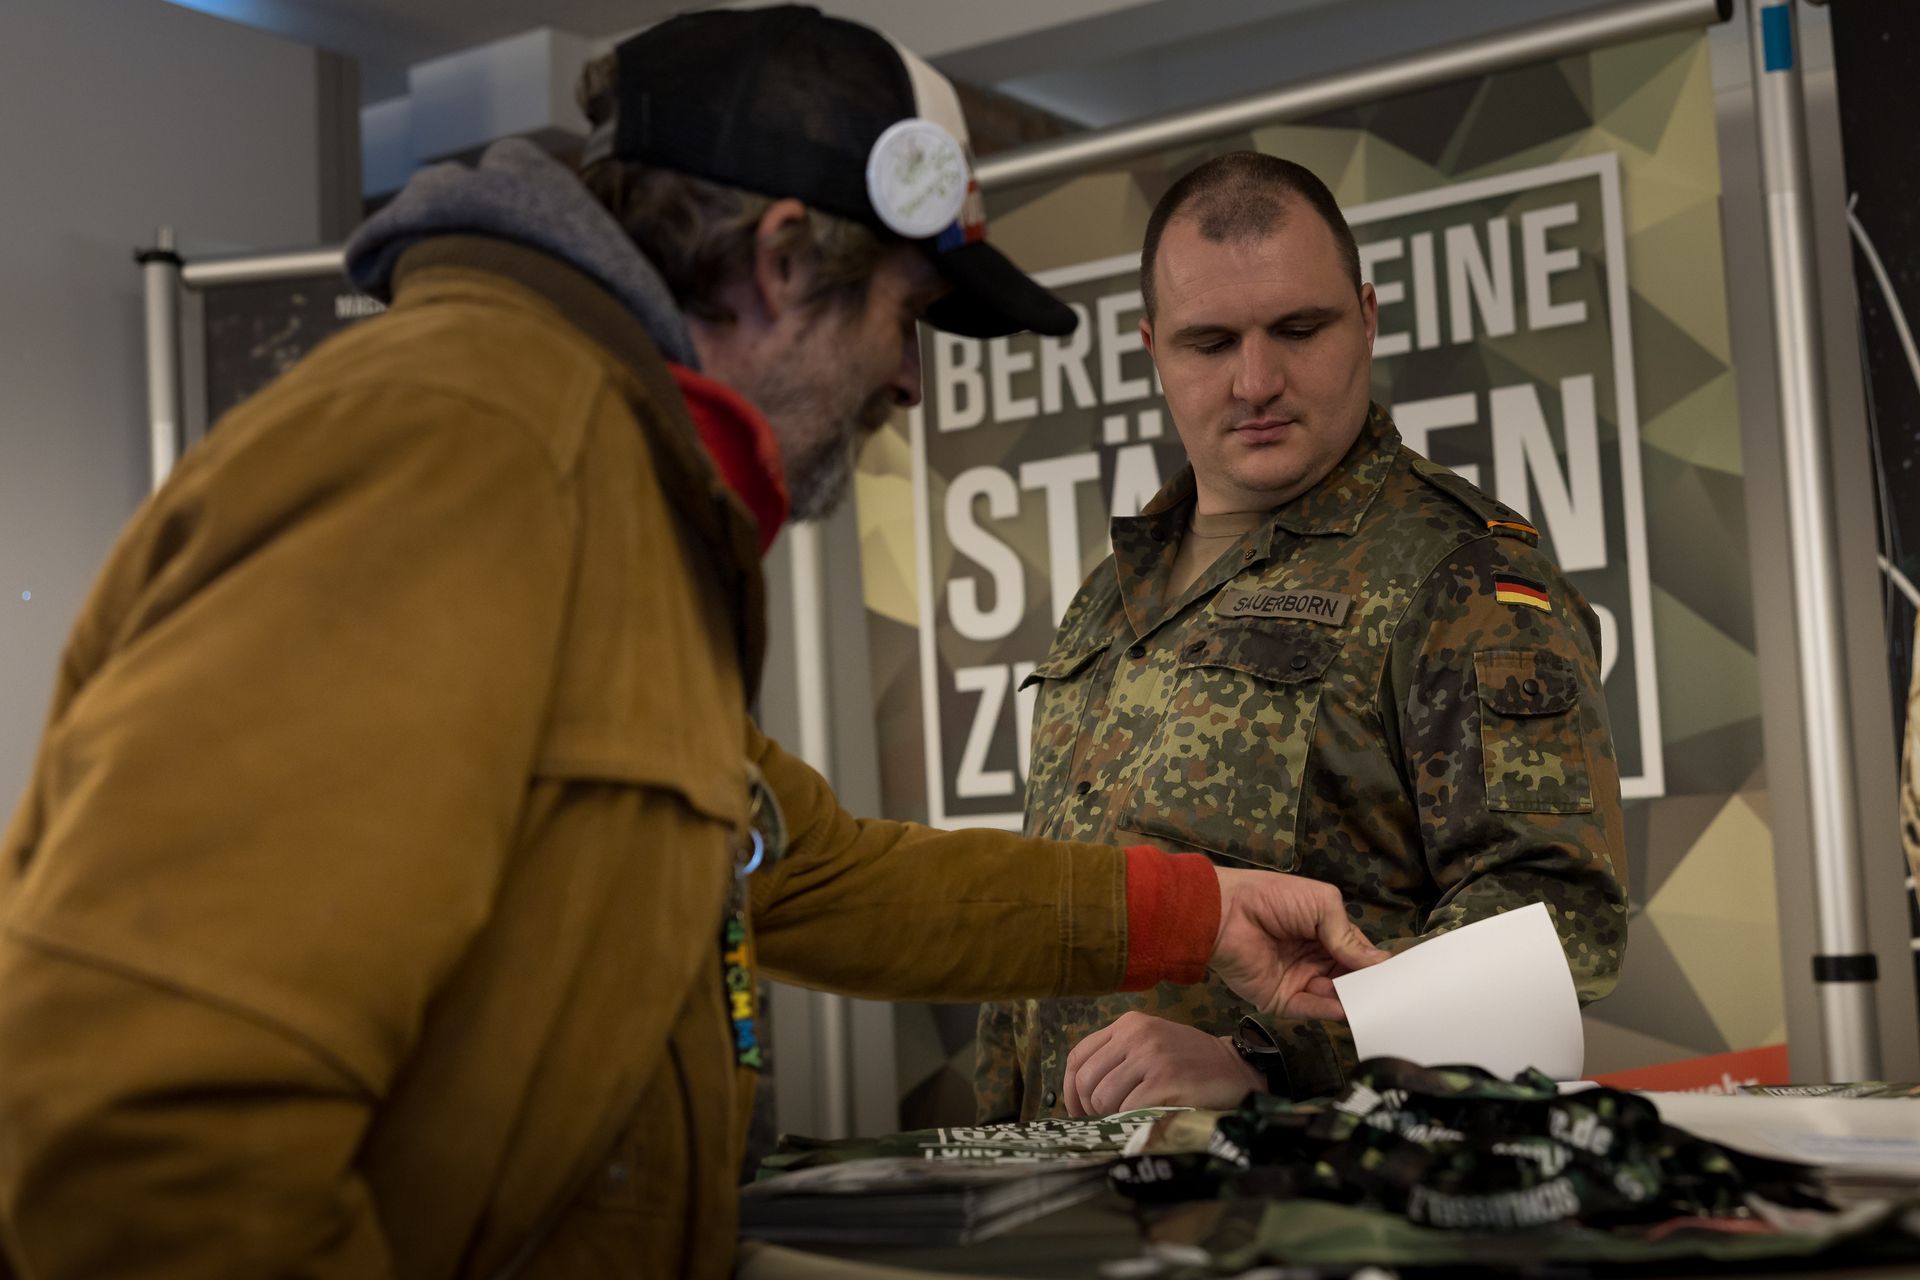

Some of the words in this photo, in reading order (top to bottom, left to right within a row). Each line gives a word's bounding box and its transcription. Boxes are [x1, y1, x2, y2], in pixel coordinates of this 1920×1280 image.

[934, 289, 1164, 433] BERE
[1359, 202, 1588, 360] EINE
[1233, 594, 1339, 617] SAUERBORN
